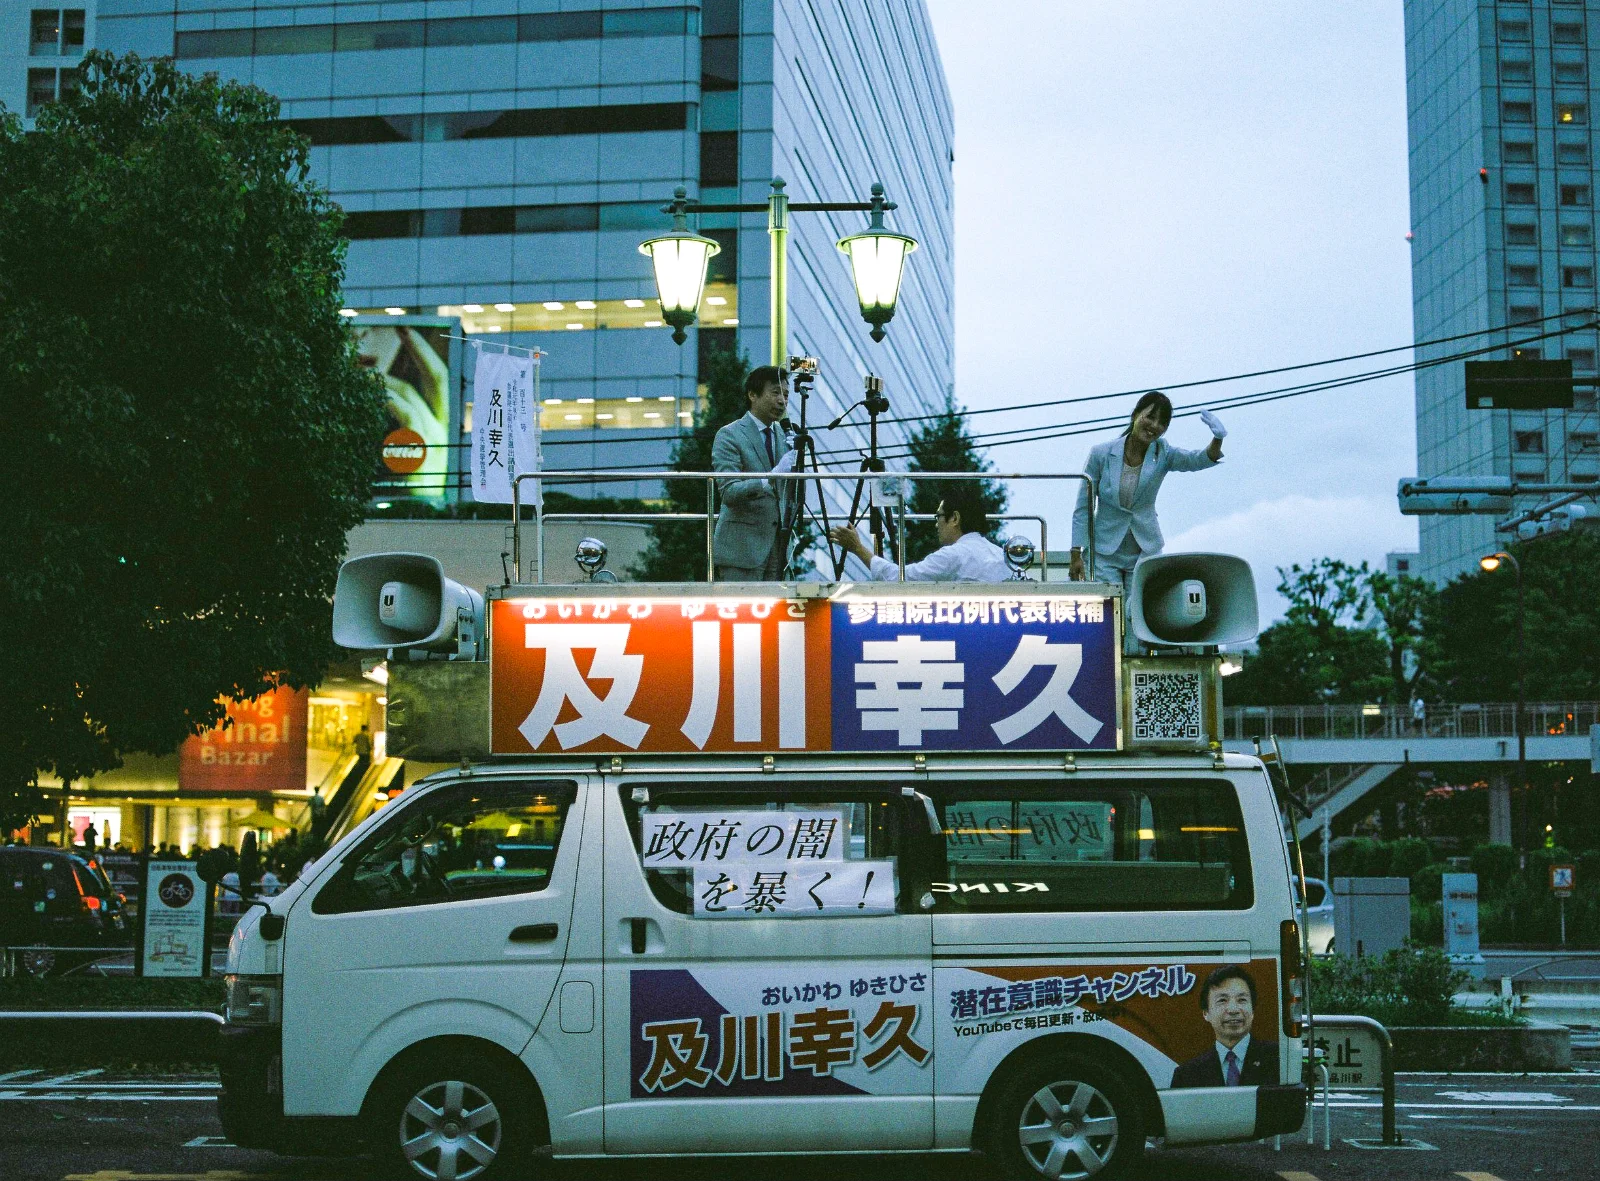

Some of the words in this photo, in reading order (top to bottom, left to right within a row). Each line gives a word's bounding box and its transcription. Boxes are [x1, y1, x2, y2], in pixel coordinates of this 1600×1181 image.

[487, 389, 504, 468] 及川幸久
[848, 600, 1104, 624] 参議院比例代表候補
[201, 745, 274, 766] Bazar
[645, 818, 838, 862] 政府の闇
[761, 981, 842, 1006] おいかわ
[849, 972, 928, 997] ゆきひさ
[949, 965, 1196, 1020] 潜在意識チャンネル
[639, 1000, 932, 1092] 及川幸久
